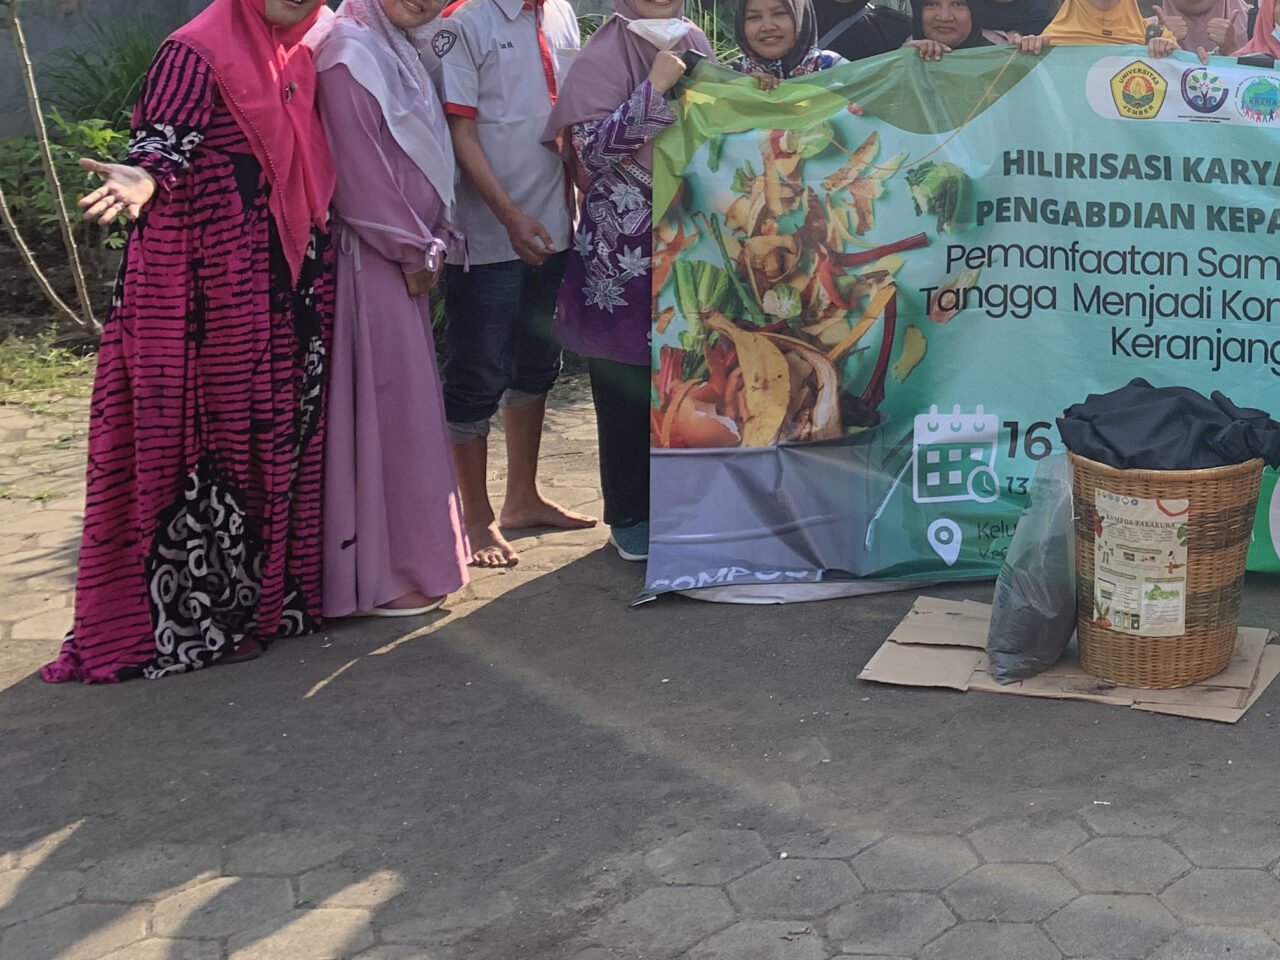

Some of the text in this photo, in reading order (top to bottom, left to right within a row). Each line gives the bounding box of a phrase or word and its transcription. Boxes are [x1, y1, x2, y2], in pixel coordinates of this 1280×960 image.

[1119, 67, 1160, 87] UNIVERSITAS
[1122, 104, 1155, 117] JEMBER
[1003, 149, 1172, 182] HILIRISASI
[975, 196, 1195, 230] PENGABDIAN
[945, 240, 1188, 277] Pemanfaatan
[919, 284, 1057, 320] Tangga
[1073, 282, 1212, 328] Menjadi
[1003, 421, 1053, 461] 16
[1135, 519, 1177, 529] TAKAKURA
